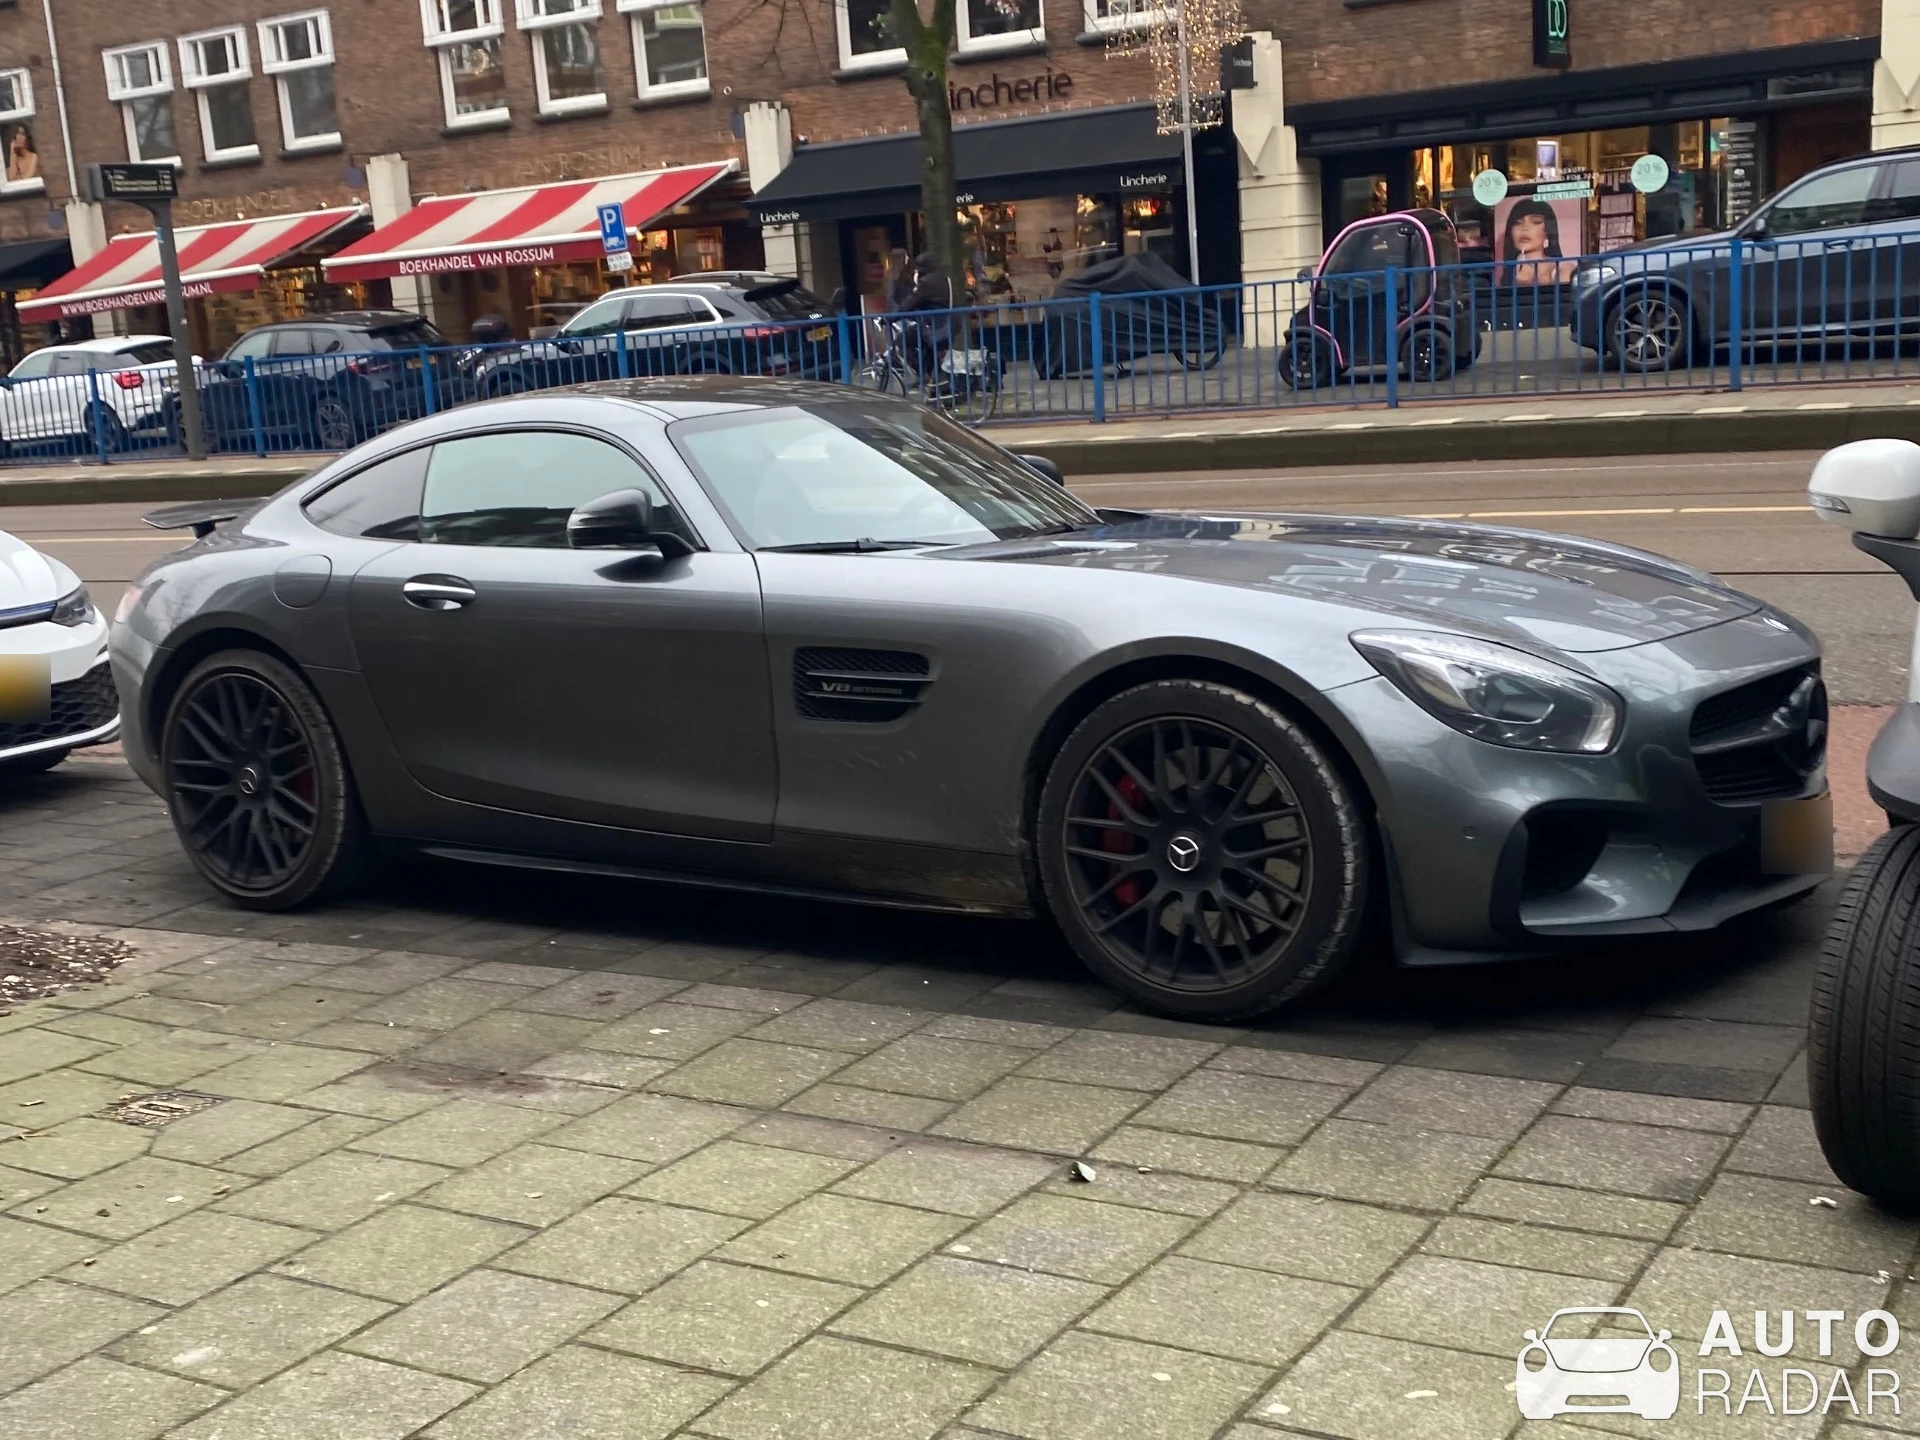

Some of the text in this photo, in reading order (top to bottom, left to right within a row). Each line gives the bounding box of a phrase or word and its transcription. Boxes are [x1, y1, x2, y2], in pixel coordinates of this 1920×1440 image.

[950, 66, 1073, 111] incherie
[1119, 173, 1168, 187] Lincherie
[602, 208, 617, 233] P
[760, 210, 800, 223] Lincherie
[399, 247, 554, 274] BOEKHANDEL VAN ROSSUM
[60, 282, 214, 315] WWW.BOEKHANDELVANRUM.NL
[821, 681, 850, 692] V8
